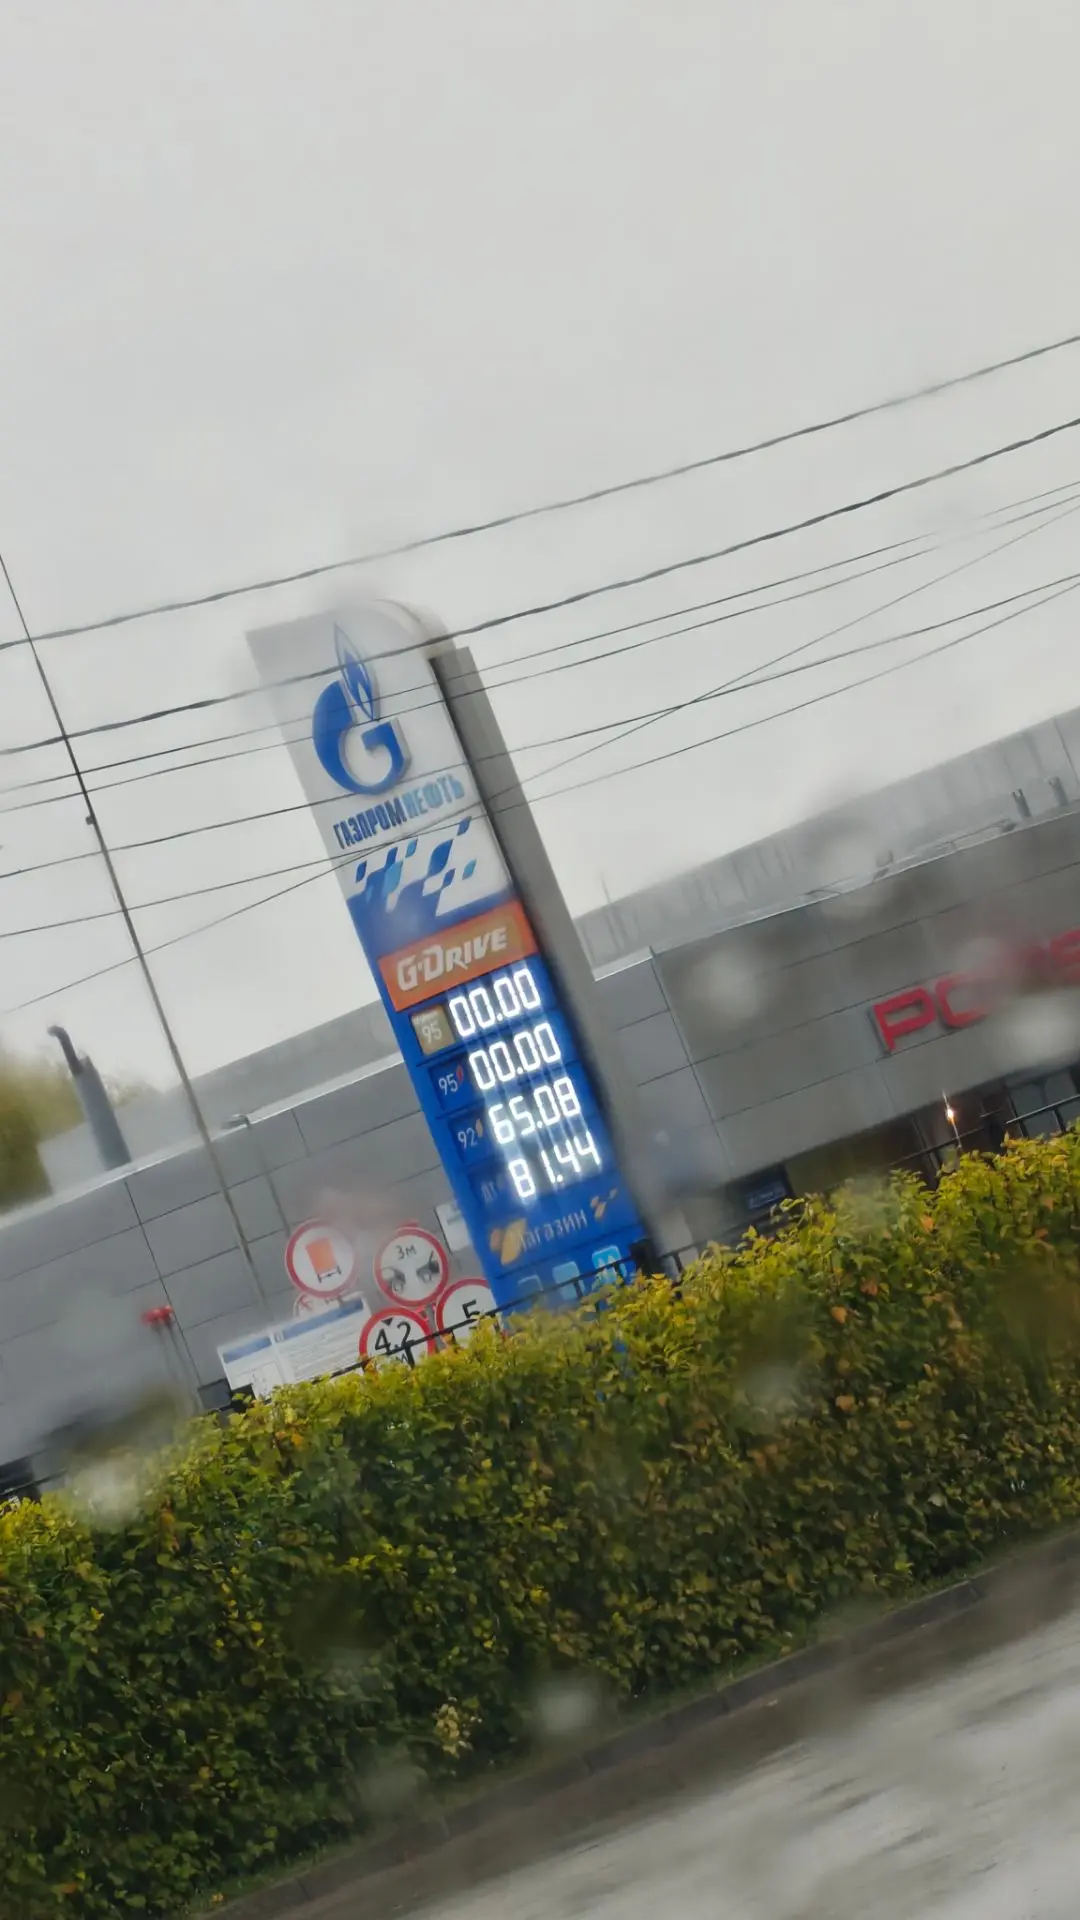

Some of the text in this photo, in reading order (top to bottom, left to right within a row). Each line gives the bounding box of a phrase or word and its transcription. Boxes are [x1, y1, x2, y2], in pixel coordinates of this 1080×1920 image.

[422, 1020, 442, 1045] 95
[449, 967, 542, 1037] 00.00
[438, 1075, 459, 1096] 95
[469, 1022, 562, 1090] 00.00
[457, 1126, 479, 1149] 92
[488, 1076, 582, 1144] 65.08
[508, 1130, 602, 1198] 81.44
